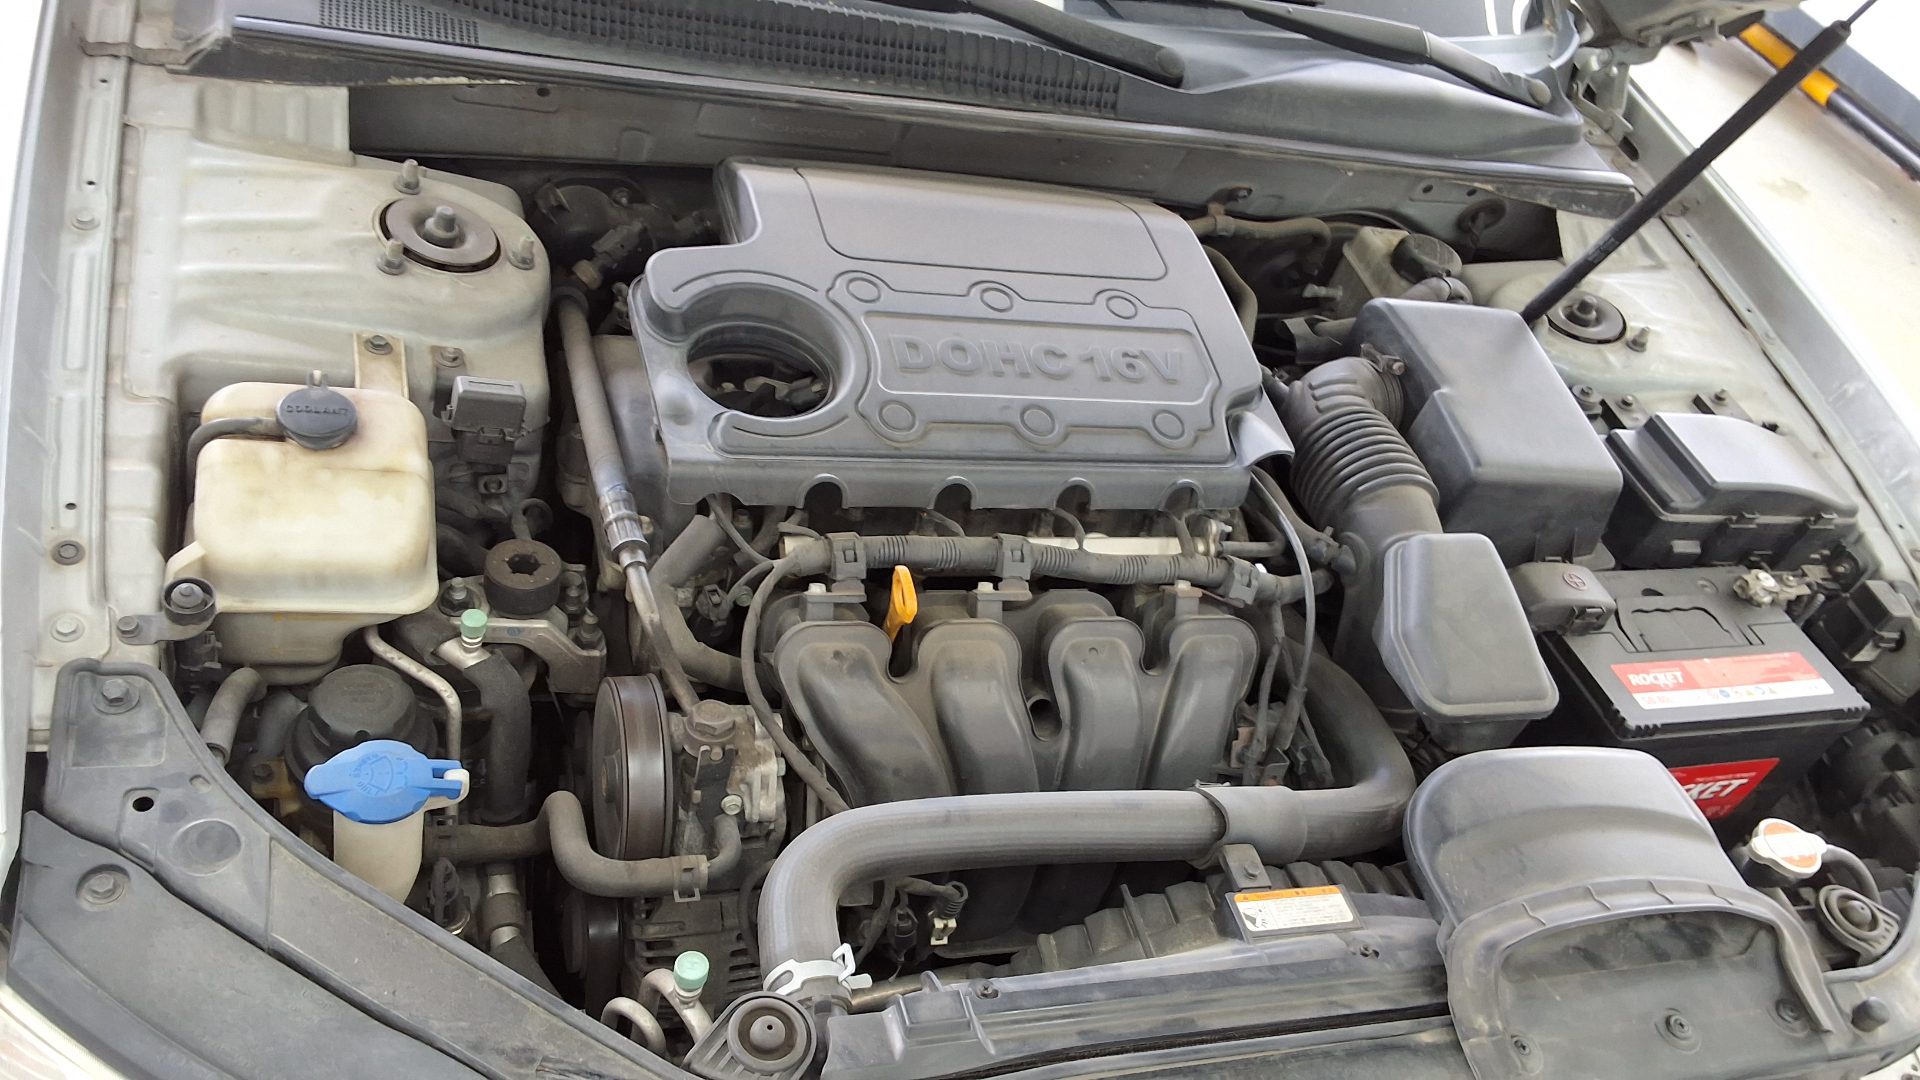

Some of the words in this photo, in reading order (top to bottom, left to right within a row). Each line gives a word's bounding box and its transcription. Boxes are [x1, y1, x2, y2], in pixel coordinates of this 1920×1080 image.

[889, 333, 1074, 381] DOHC
[1080, 345, 1184, 385] 16V
[285, 404, 349, 416] COOLANT
[1627, 671, 1684, 688] ROCKET
